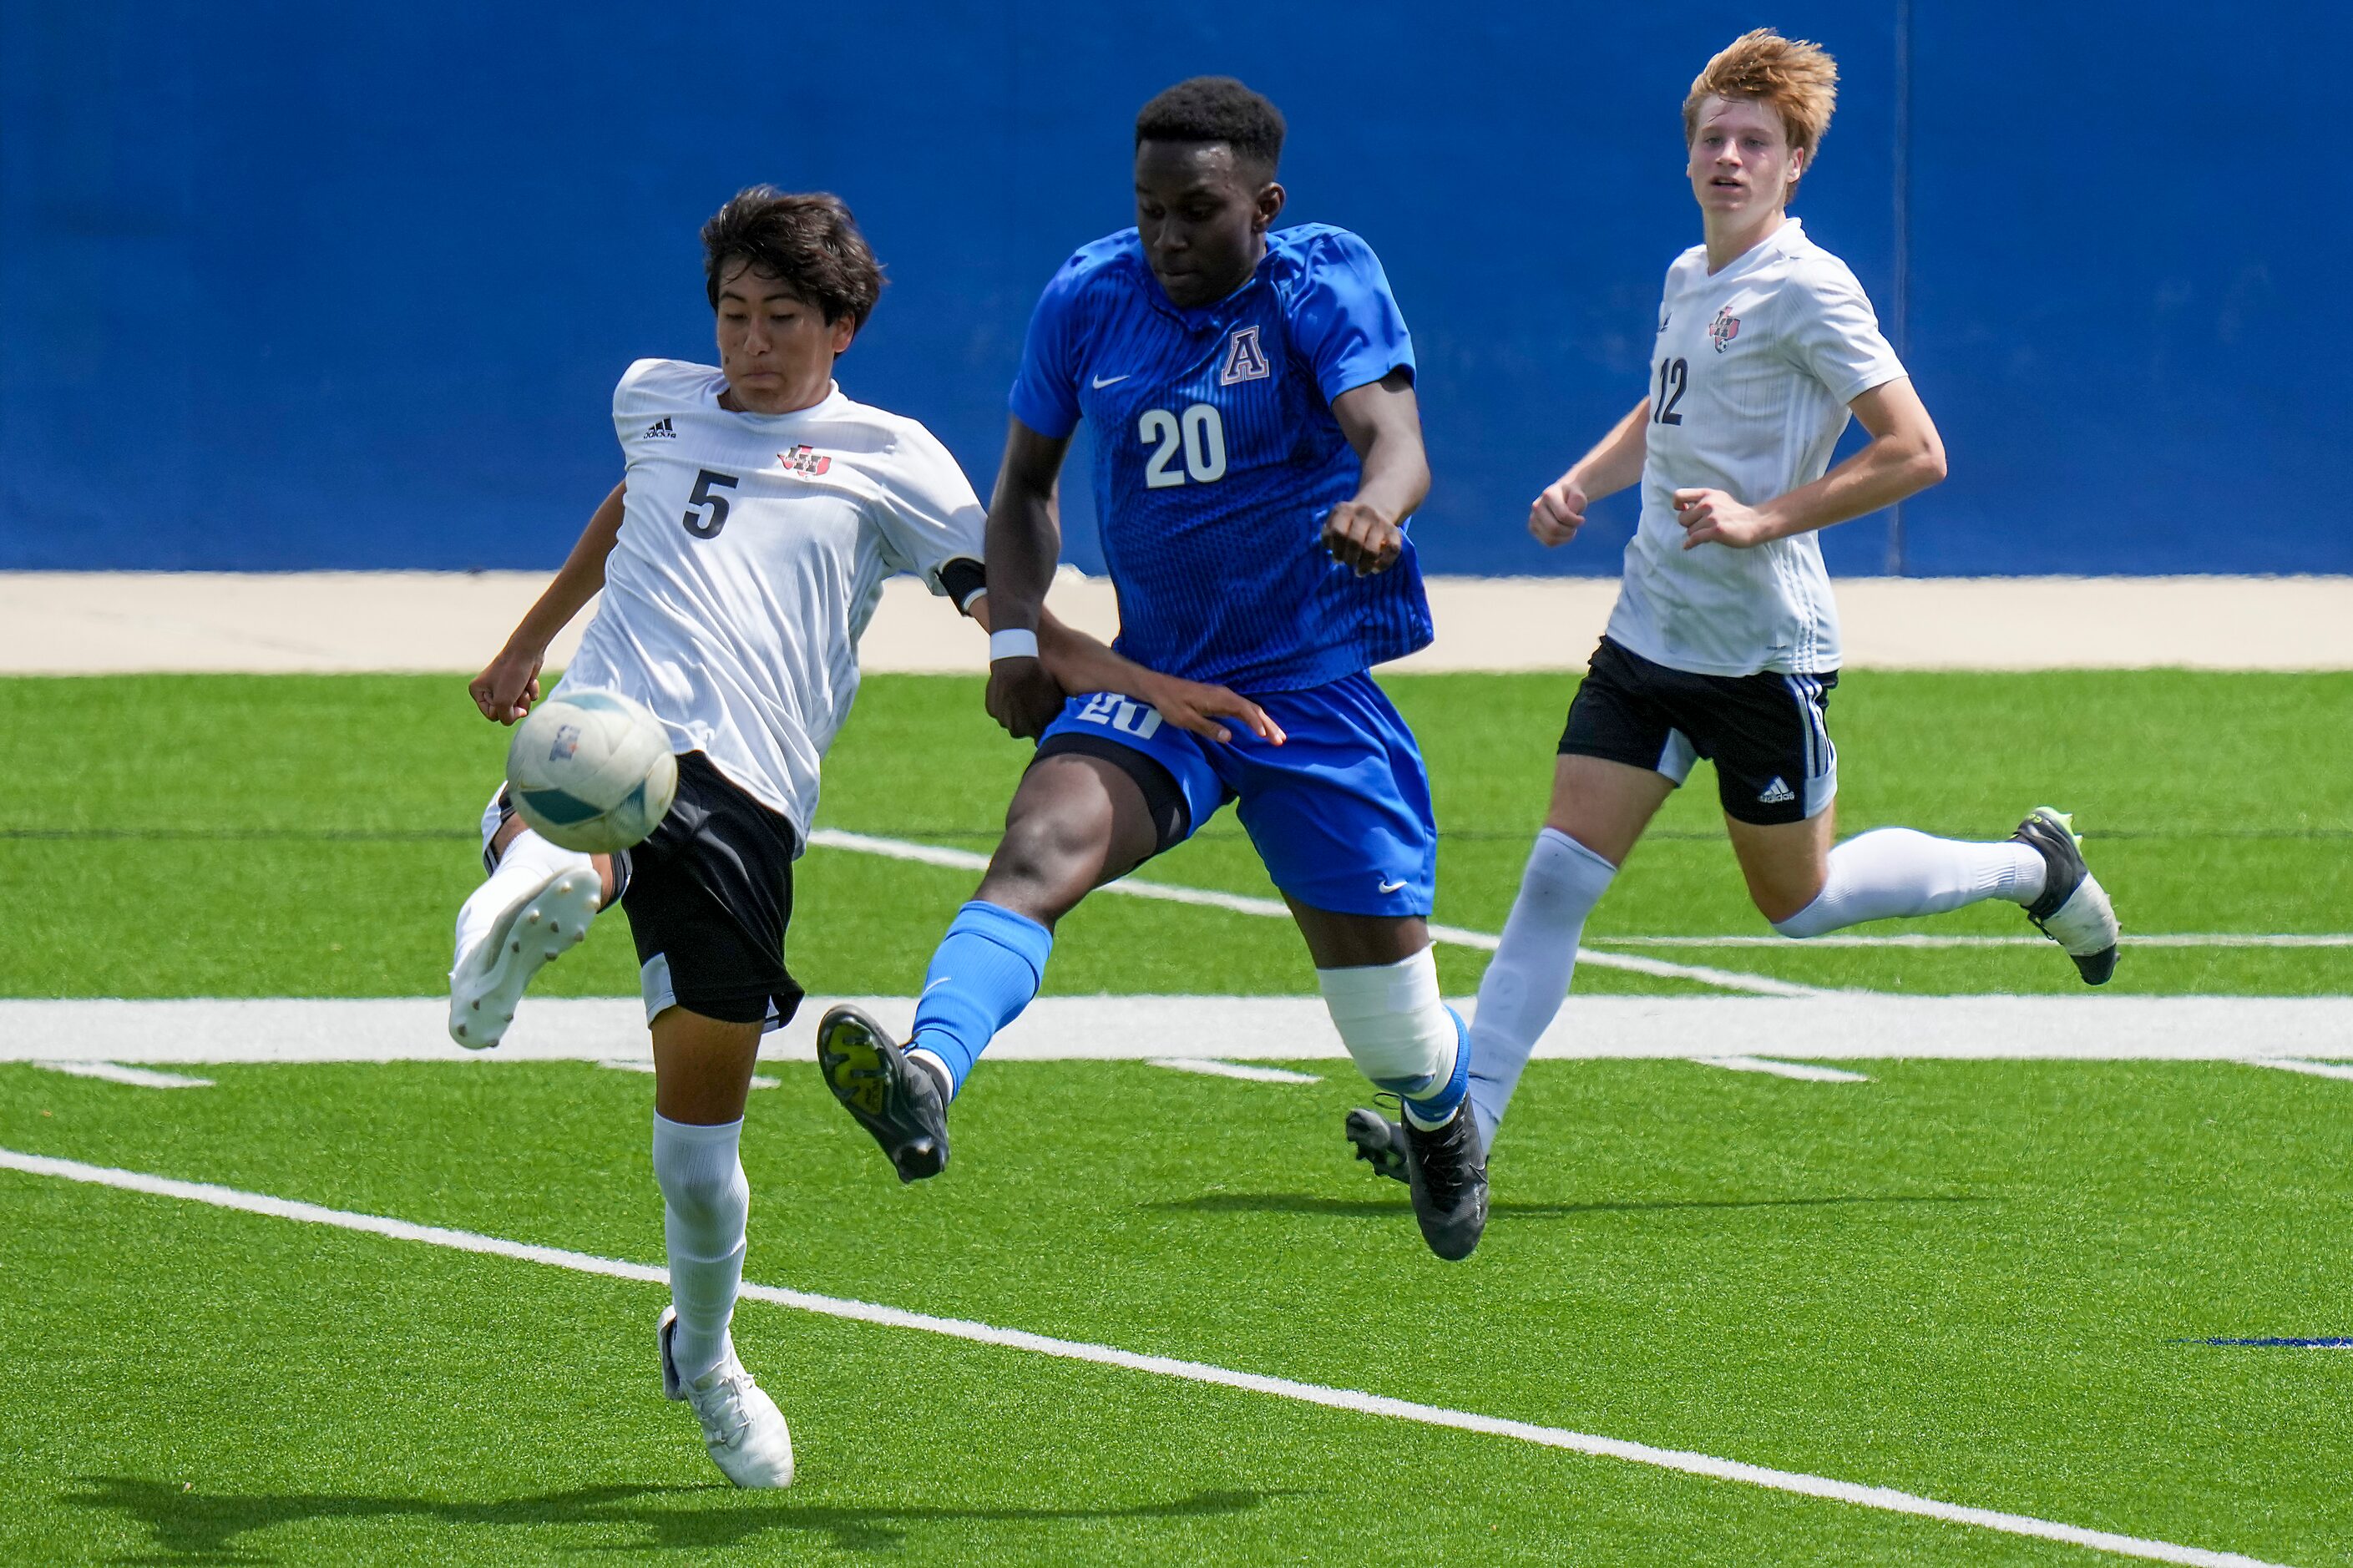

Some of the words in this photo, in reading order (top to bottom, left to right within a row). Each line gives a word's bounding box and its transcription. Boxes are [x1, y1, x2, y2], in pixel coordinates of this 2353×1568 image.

[1221, 326, 1269, 385] A
[1654, 357, 1688, 426] 12
[1139, 403, 1226, 488] 20
[683, 469, 739, 539] 5
[1075, 692, 1163, 740] 20
